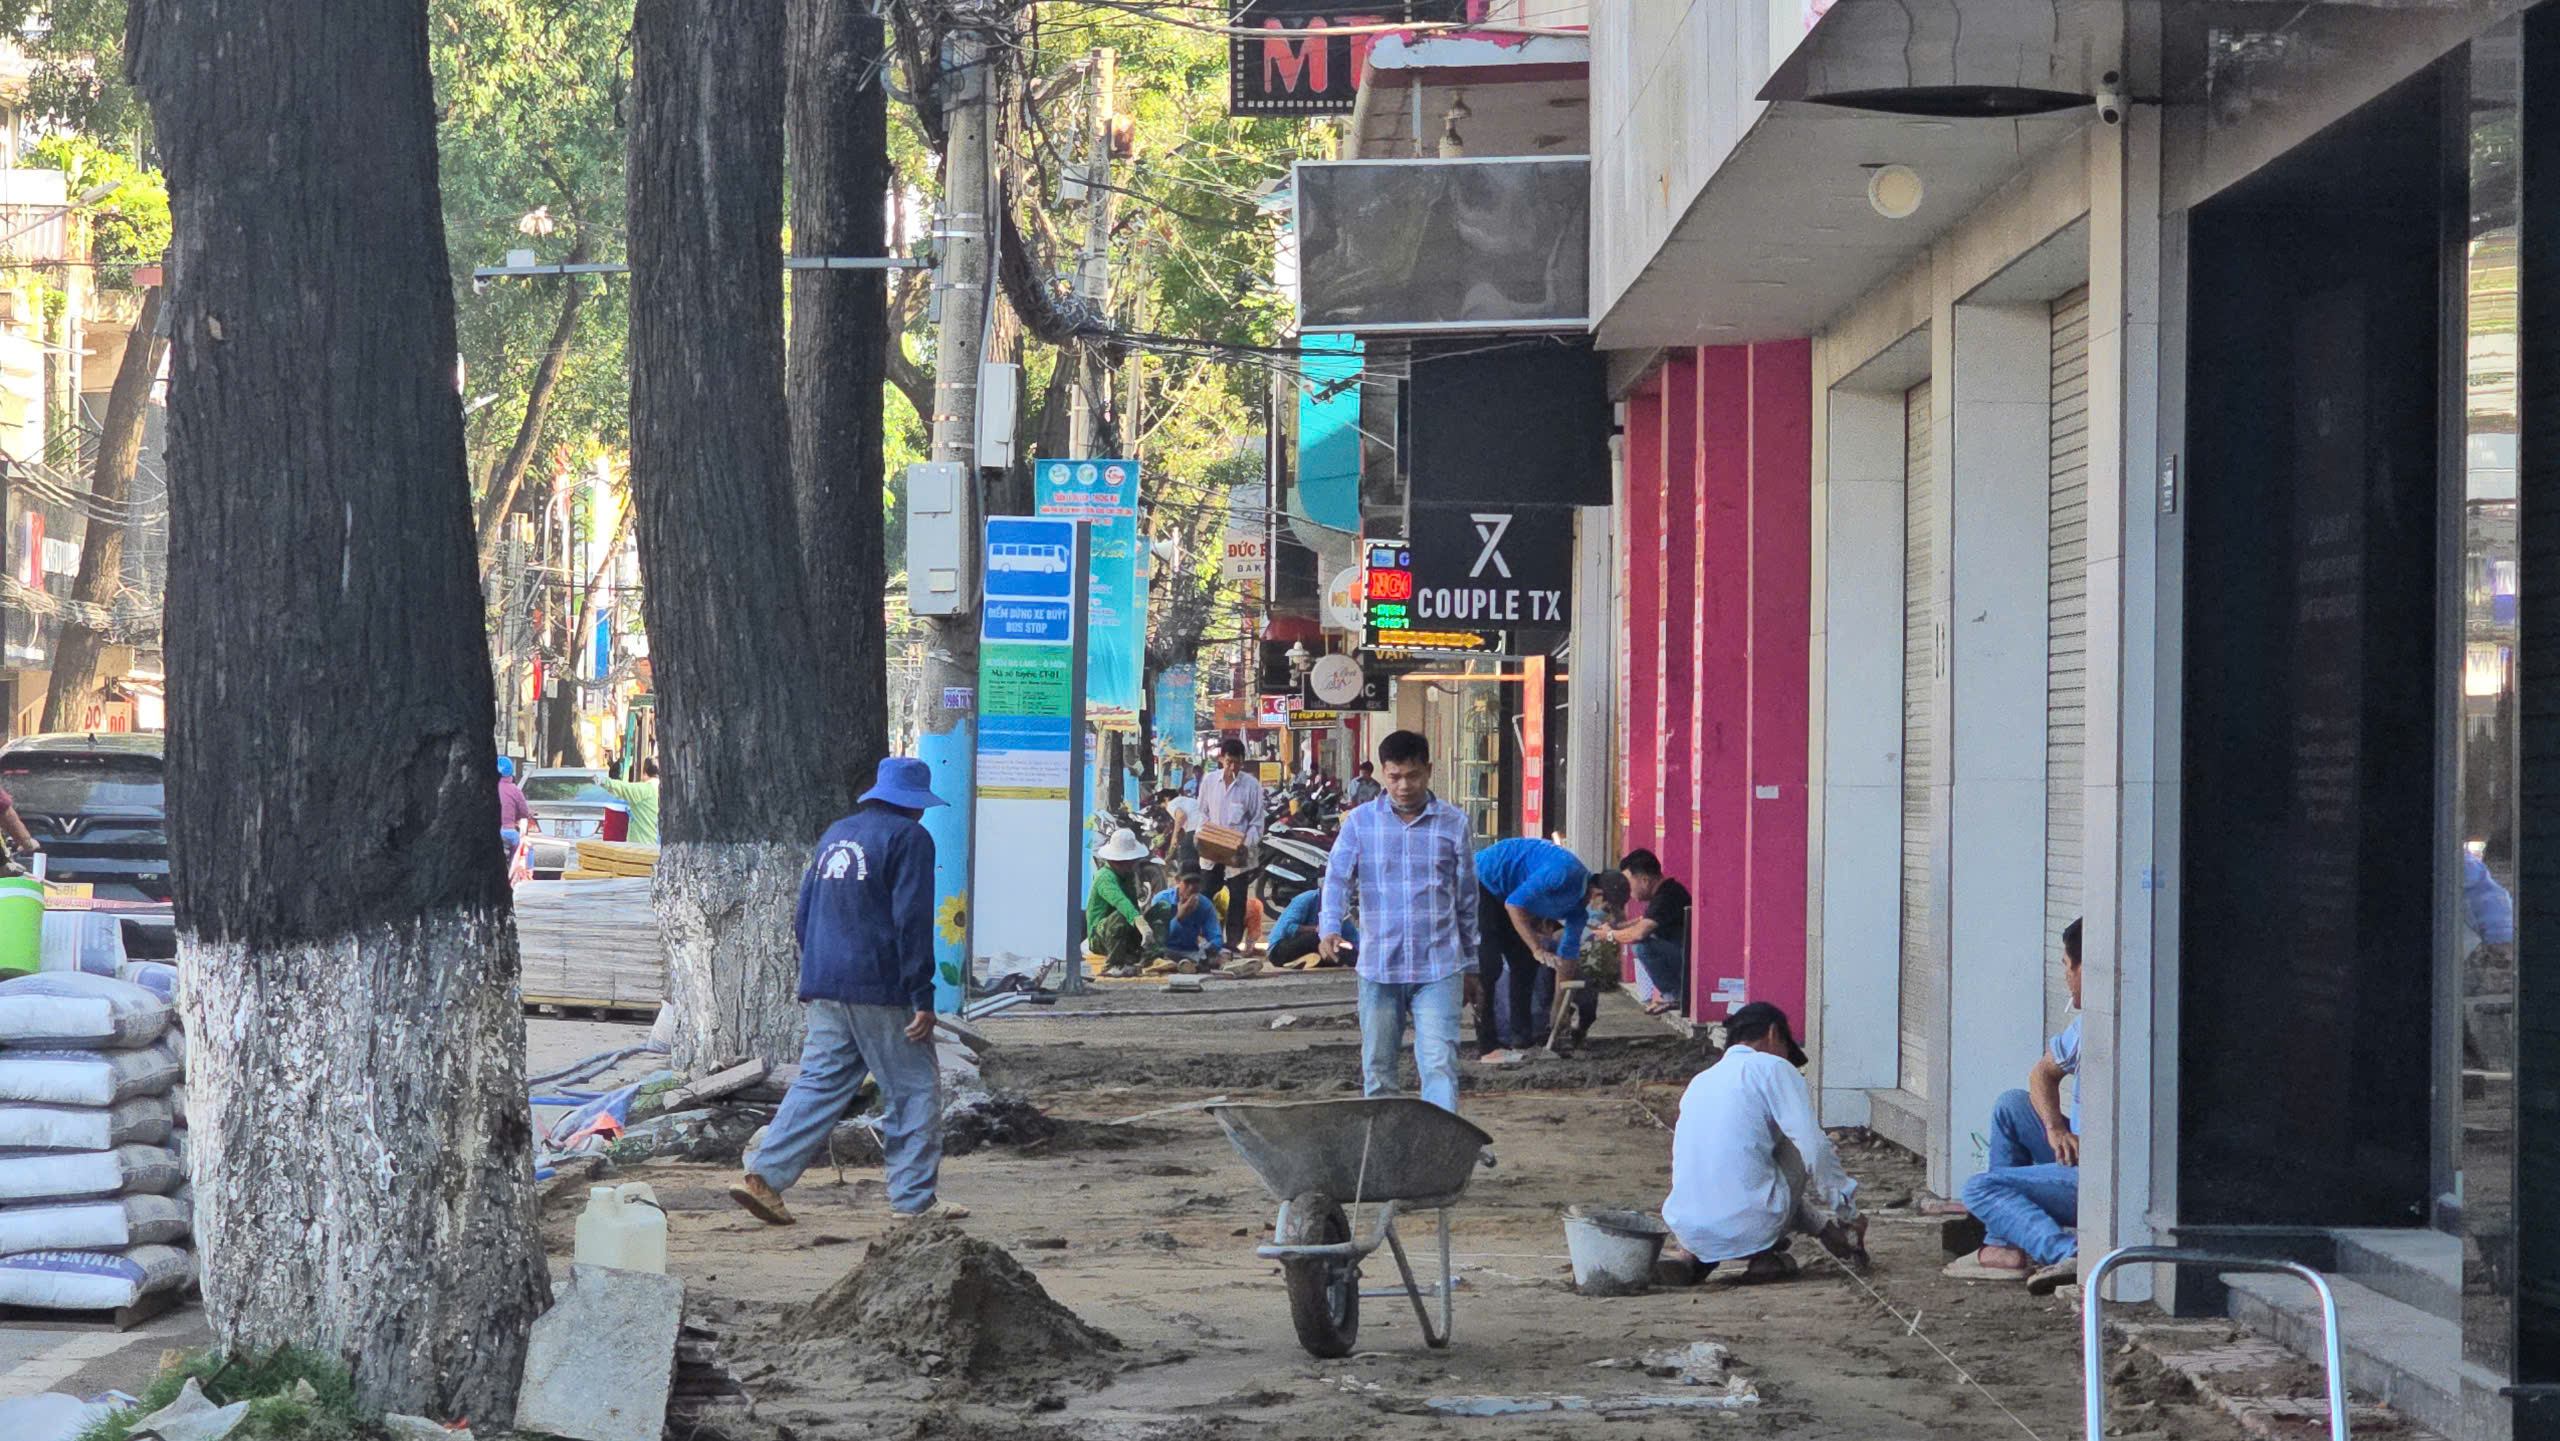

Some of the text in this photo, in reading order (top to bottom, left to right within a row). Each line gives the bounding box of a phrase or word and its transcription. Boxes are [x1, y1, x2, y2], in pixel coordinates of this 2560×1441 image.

[1228, 540, 1256, 557] ĐỨC
[988, 604, 1008, 618] ĐIỂM
[1033, 608, 1045, 619] XE
[1418, 587, 1561, 620] COUPLE TX
[1006, 622, 1048, 633] BUS STOP
